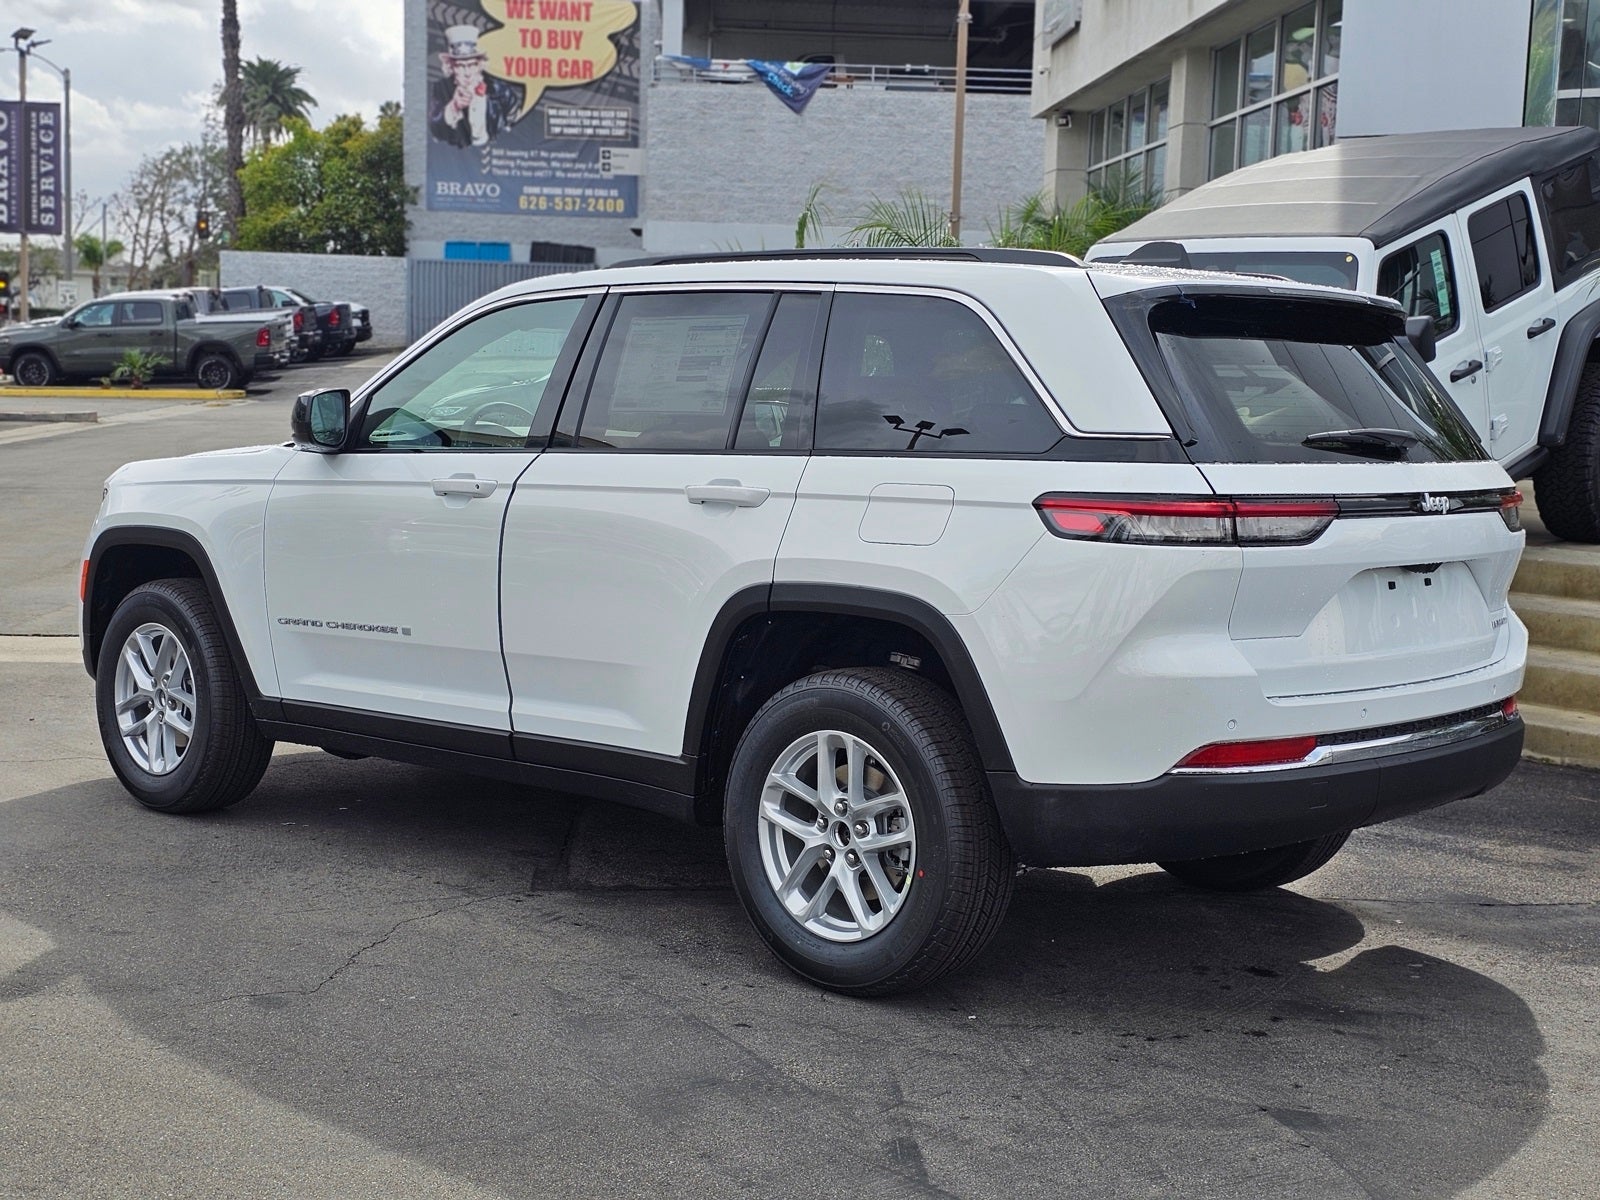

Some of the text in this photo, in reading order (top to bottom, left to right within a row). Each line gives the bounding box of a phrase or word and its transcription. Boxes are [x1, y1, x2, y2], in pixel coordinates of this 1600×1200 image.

[505, 0, 593, 22] WE WANT
[519, 28, 583, 51] TO BUY
[504, 55, 594, 79] YOUR CAR
[39, 112, 55, 226] SERVICE
[436, 182, 501, 198] BRAVO
[519, 195, 625, 213] 626-537-2400
[60, 293, 76, 305] 35
[1421, 492, 1450, 515] Jeep
[277, 617, 399, 635] GRAND CHEROKEE
